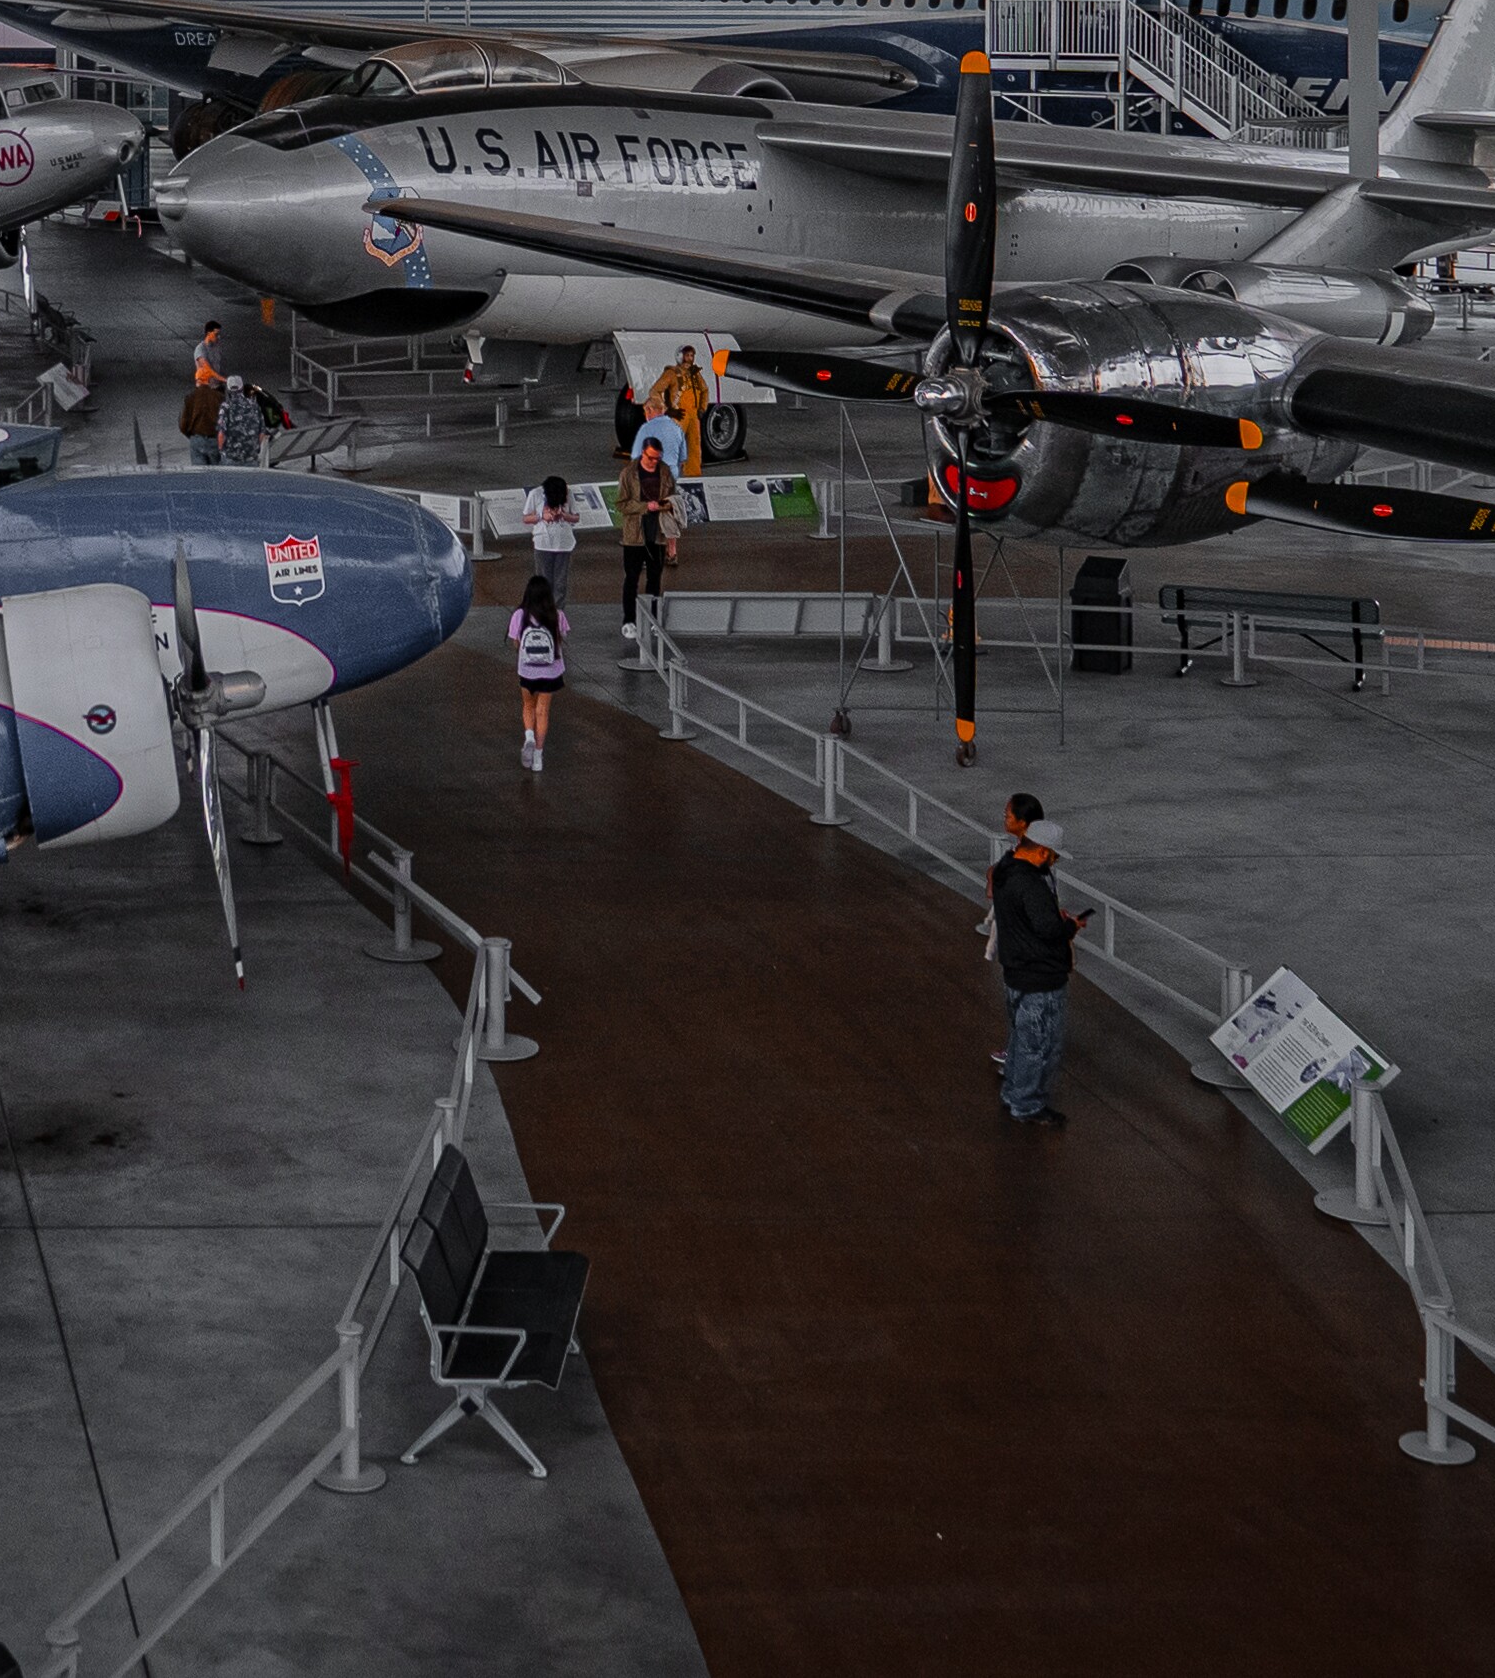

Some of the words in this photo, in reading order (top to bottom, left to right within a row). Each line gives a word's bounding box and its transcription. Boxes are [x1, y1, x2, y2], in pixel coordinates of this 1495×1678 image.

[174, 32, 217, 46] DREA
[416, 126, 526, 177] U.S.
[533, 129, 607, 182] AIR
[614, 134, 757, 191] FORCE
[268, 542, 318, 562] UNITED
[274, 568, 291, 578] AIR
[293, 564, 319, 576] LINES
